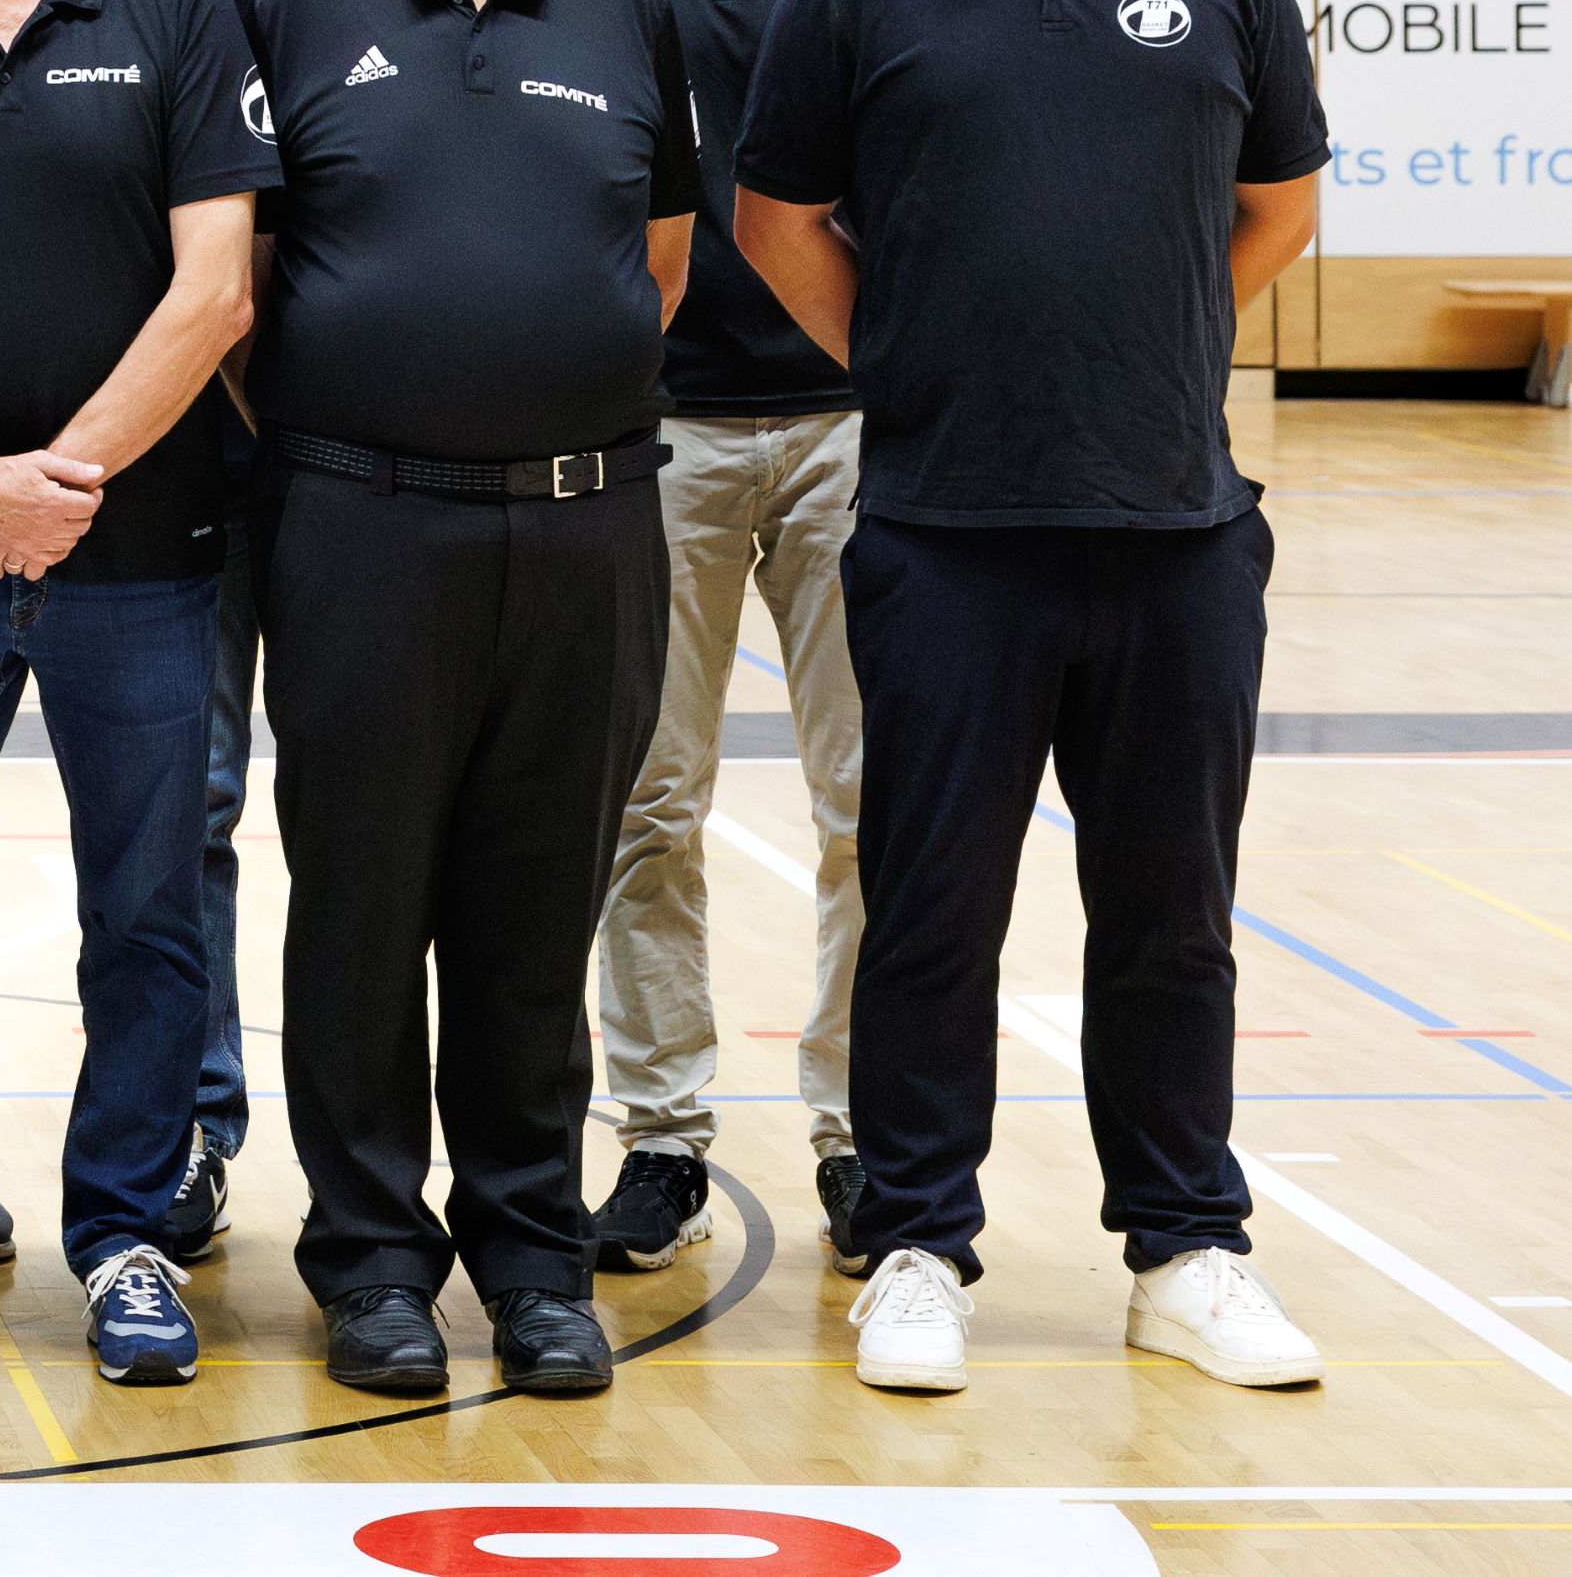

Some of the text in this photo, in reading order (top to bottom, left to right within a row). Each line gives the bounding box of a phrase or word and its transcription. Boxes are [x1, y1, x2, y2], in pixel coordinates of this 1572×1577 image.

[46, 63, 141, 85] COMITÉ
[344, 62, 608, 113] adidas COMITÉ
[1408, 140, 1473, 186] et
